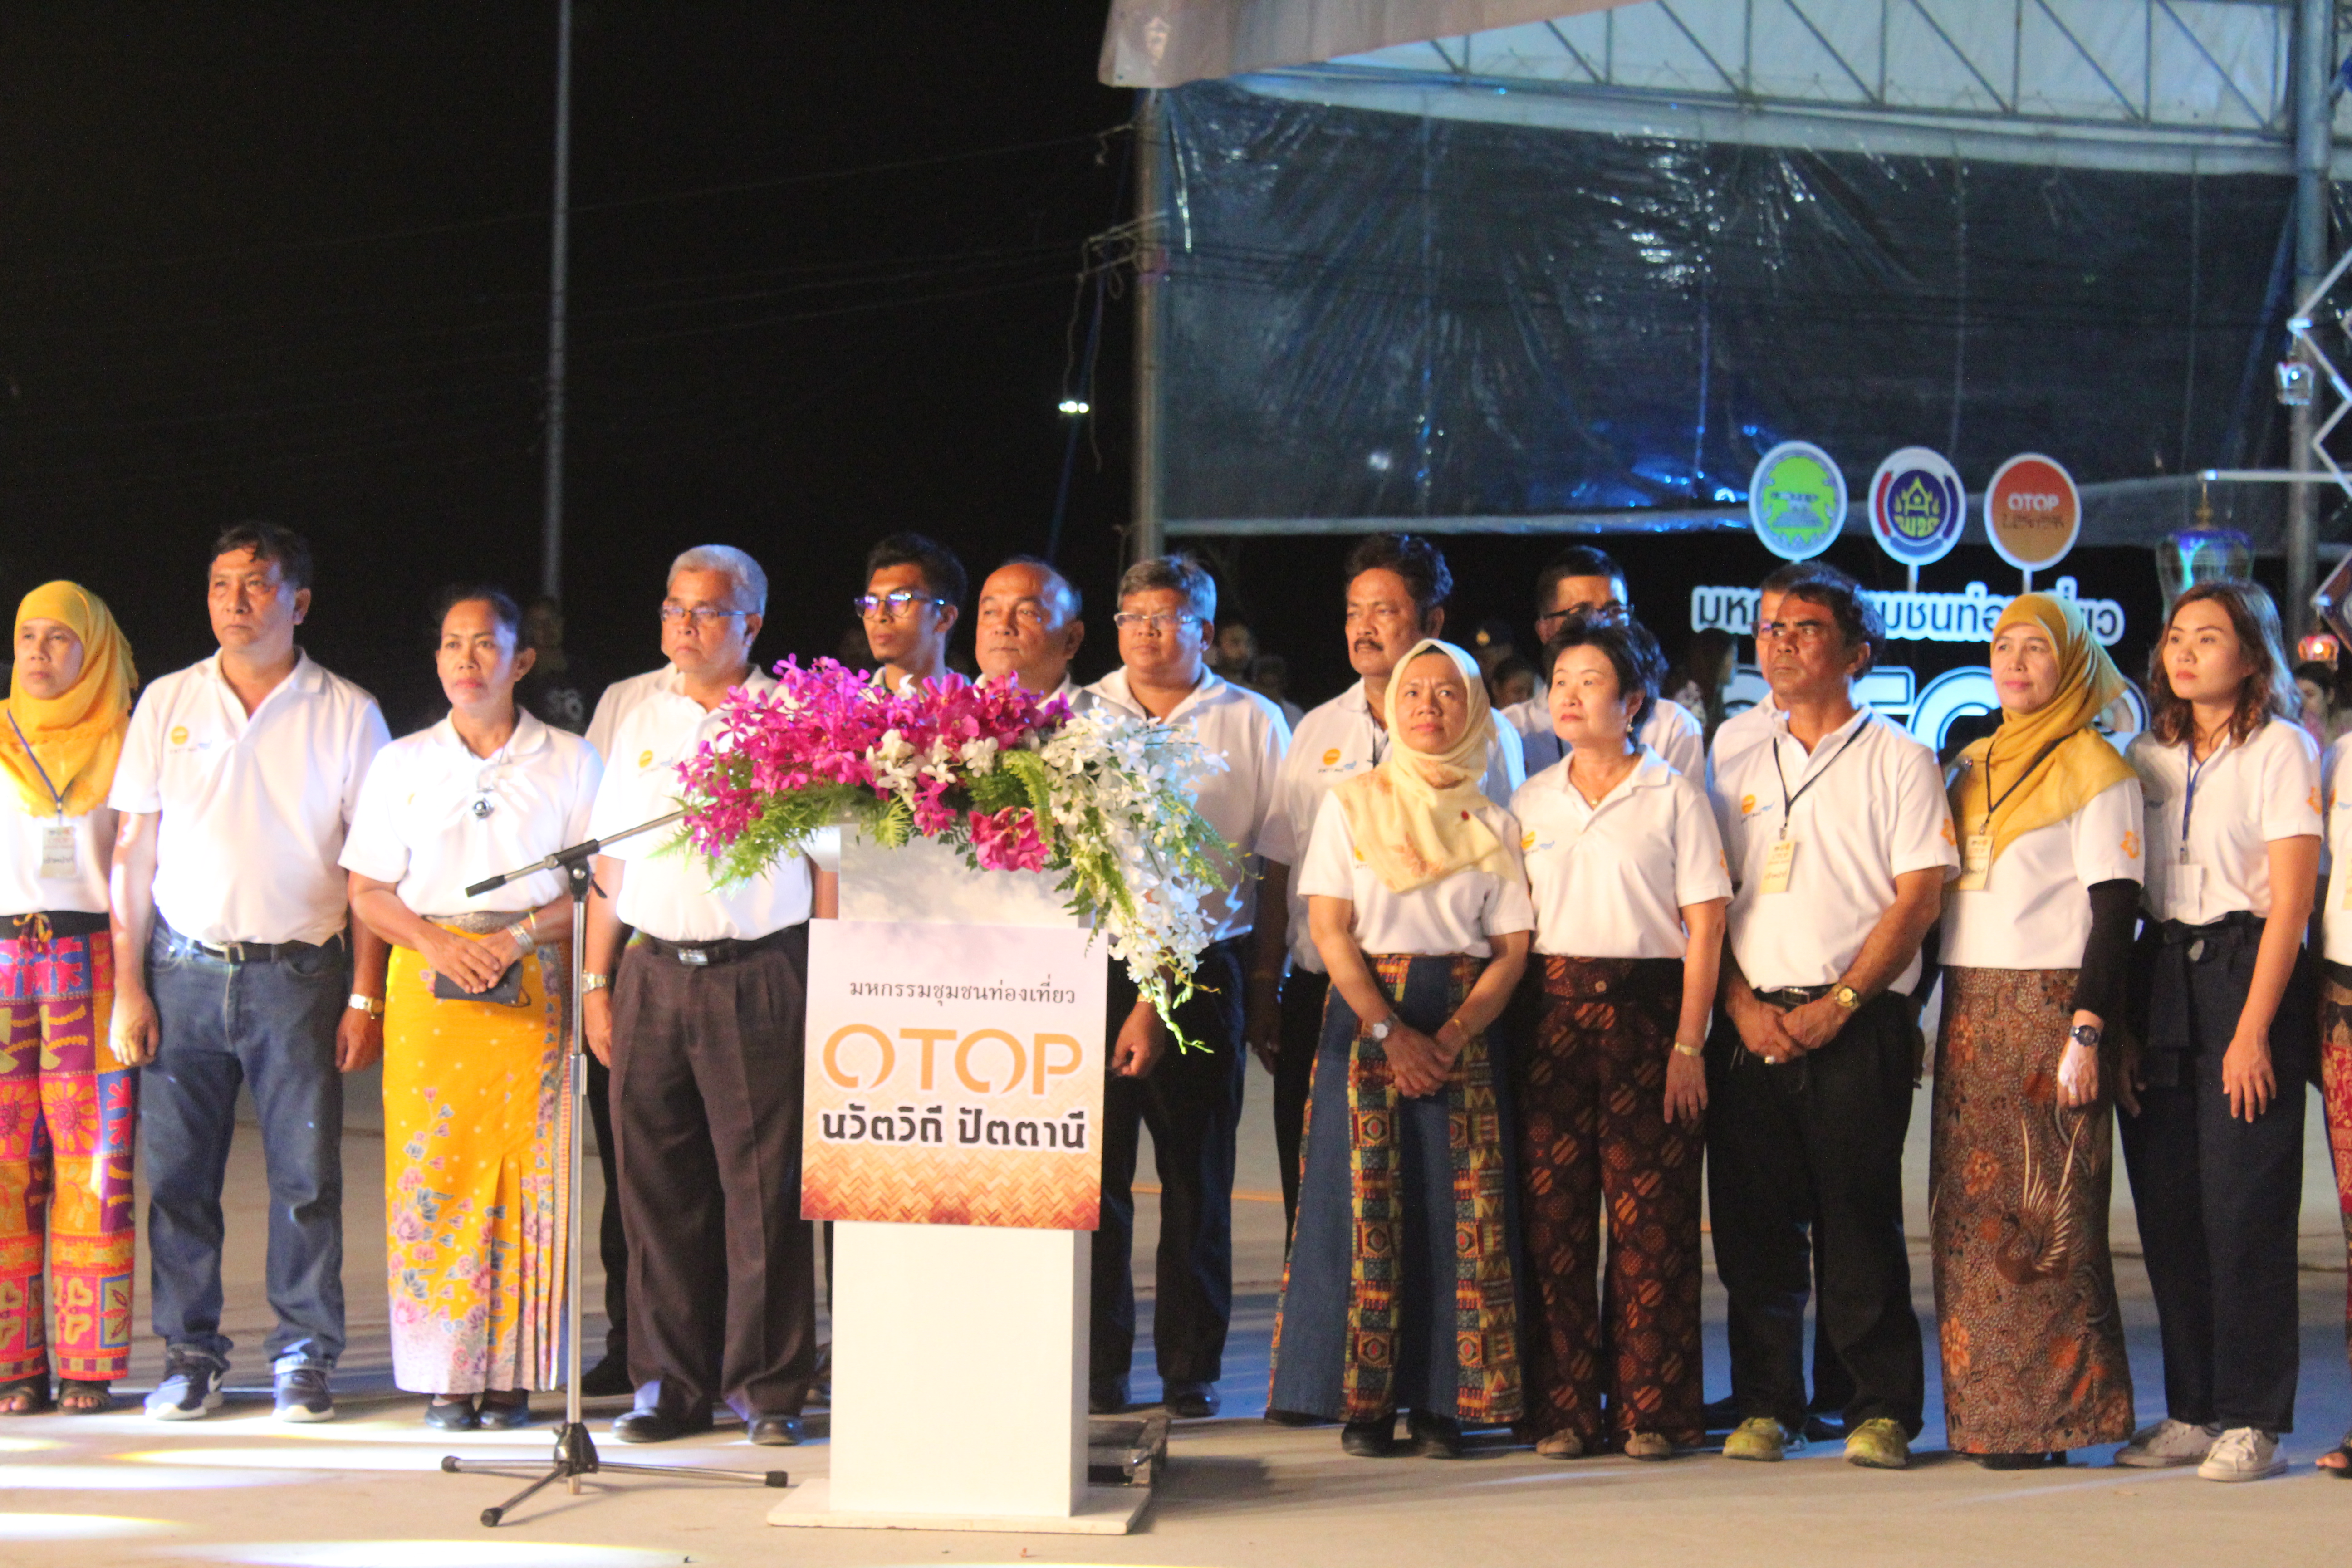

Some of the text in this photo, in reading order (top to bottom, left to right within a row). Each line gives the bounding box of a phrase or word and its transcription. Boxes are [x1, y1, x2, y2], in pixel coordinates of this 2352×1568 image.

[2007, 493, 2059, 511] OTOP
[850, 974, 1075, 1006] มหกรรมชุมชนท่องเที่ยว
[823, 1024, 1083, 1095] OTOP
[823, 1103, 1085, 1148] นวัตวิถี ปัตตานี
